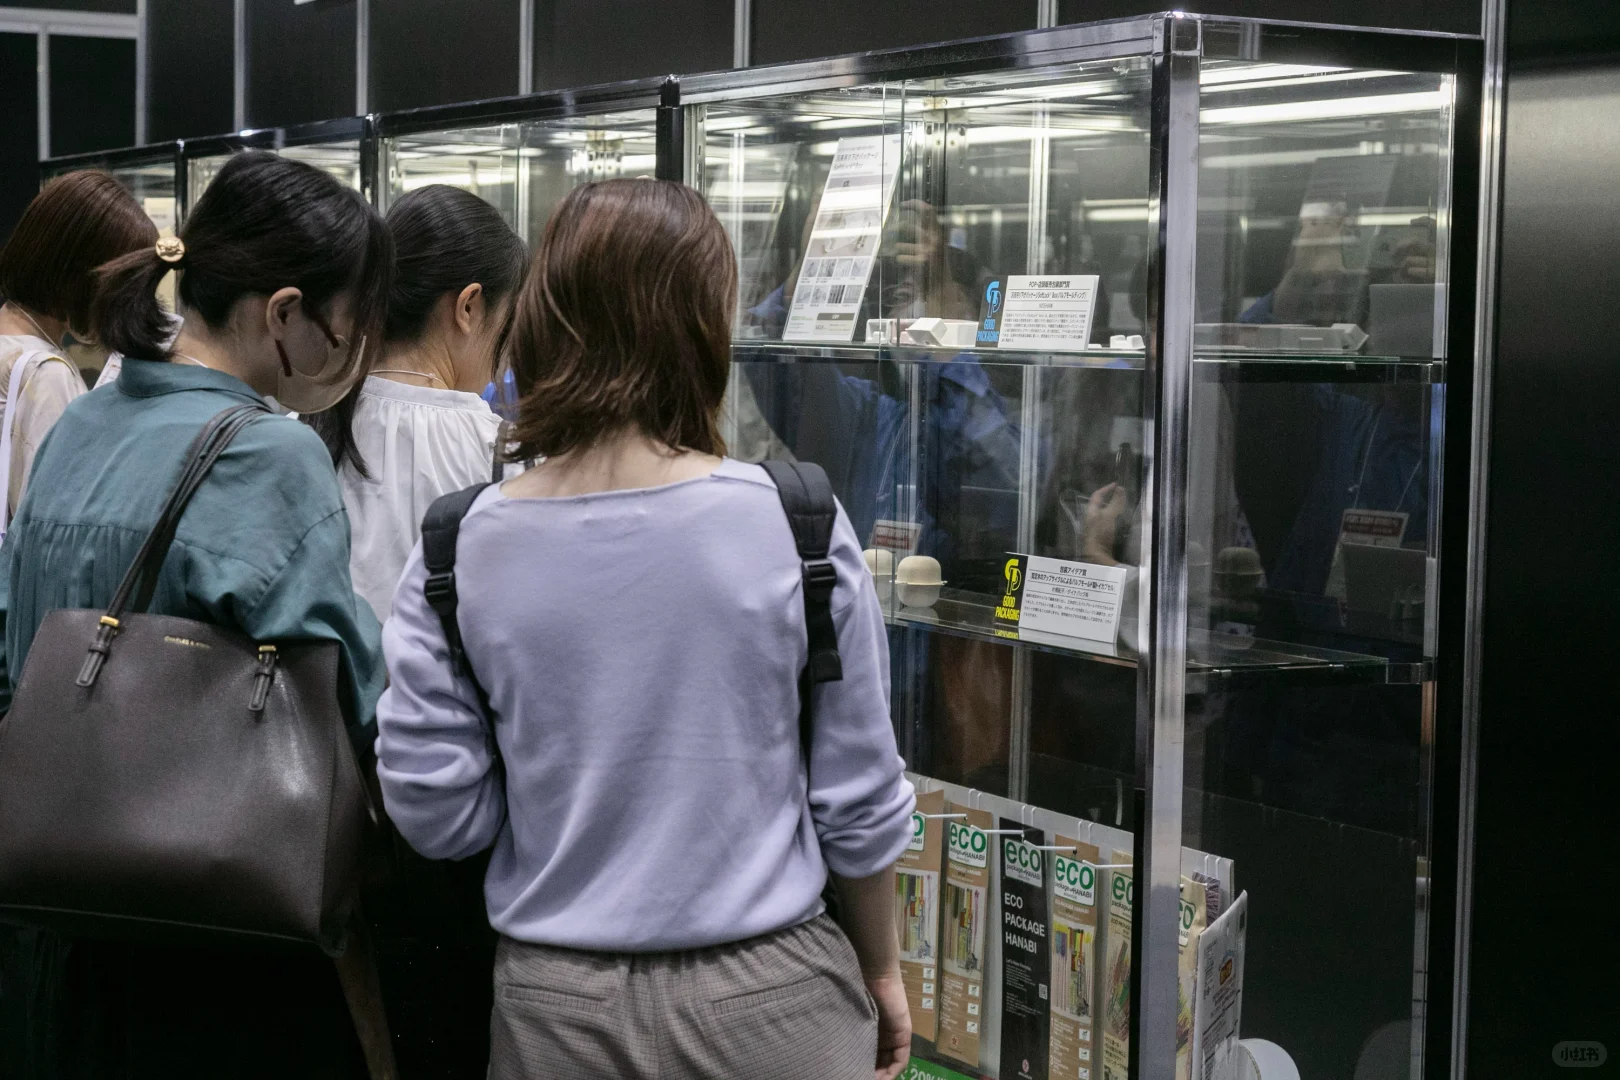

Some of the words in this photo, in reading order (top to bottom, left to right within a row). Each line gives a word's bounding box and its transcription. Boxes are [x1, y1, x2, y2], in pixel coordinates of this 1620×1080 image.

[984, 318, 996, 330] GOOD
[976, 330, 1000, 342] PACKAGING
[1060, 566, 1087, 577] 包装アイデア賞
[1002, 595, 1016, 608] GOOD
[995, 606, 1021, 621] PACKAGING
[950, 824, 986, 853] eco
[965, 852, 985, 861] HANABI
[1005, 841, 1041, 872] eco
[1055, 857, 1094, 890] eco
[1005, 892, 1023, 909] ECO
[1072, 888, 1093, 899] HANABI
[1005, 912, 1046, 937] PACKAGE
[1005, 932, 1037, 954] HANABI
